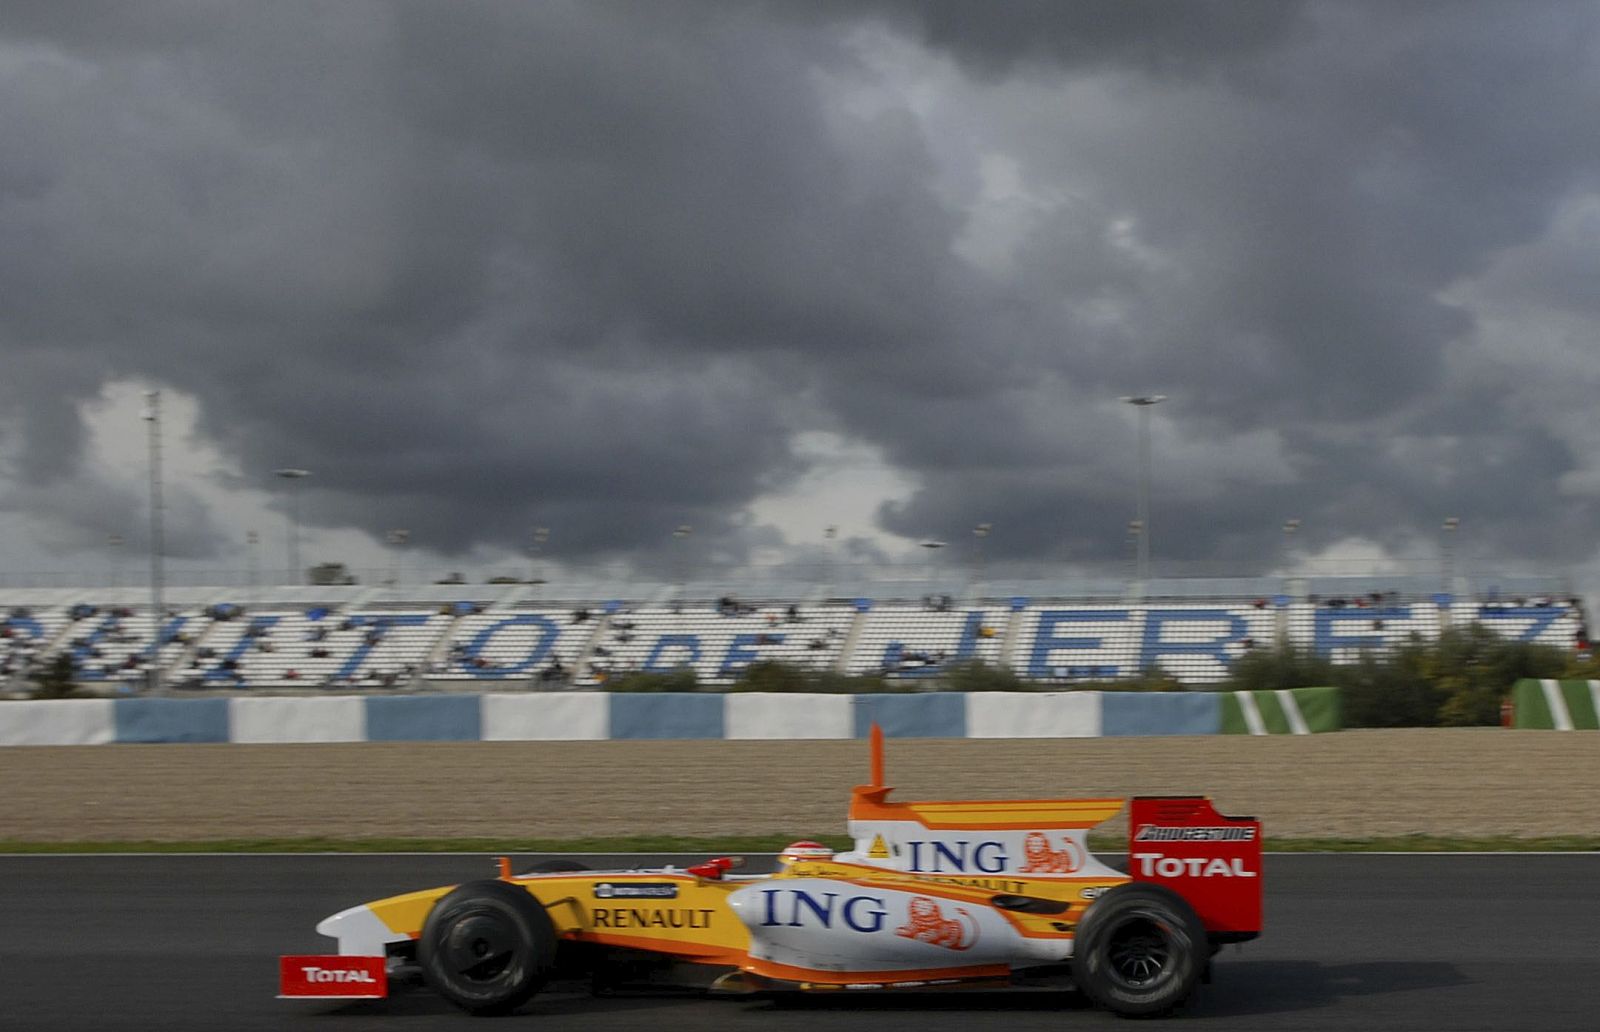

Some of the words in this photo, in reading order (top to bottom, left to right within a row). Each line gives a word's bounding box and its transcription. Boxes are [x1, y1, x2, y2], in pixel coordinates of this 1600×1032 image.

[907, 841, 1010, 873] ING
[1133, 853, 1257, 877] TOTAL
[592, 908, 716, 929] RENAULT
[760, 889, 889, 933] ING
[301, 967, 377, 983] TOTAL
